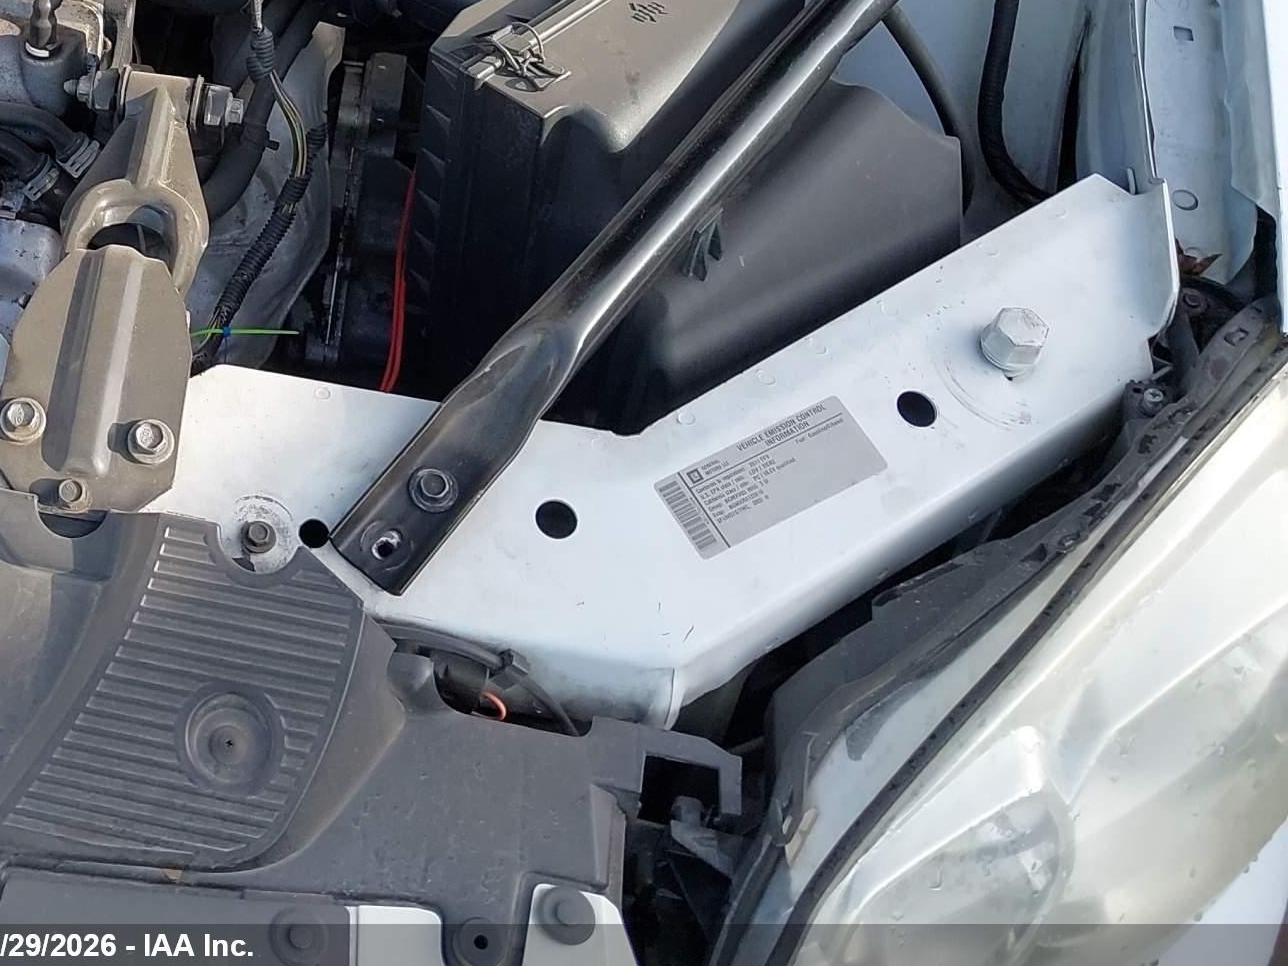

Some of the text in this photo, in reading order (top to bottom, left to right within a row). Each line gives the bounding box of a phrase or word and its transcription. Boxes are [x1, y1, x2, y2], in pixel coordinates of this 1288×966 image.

[736, 402, 826, 452] VEHICLE EMISSION CONTROL
[764, 419, 810, 447] INFORMATION
